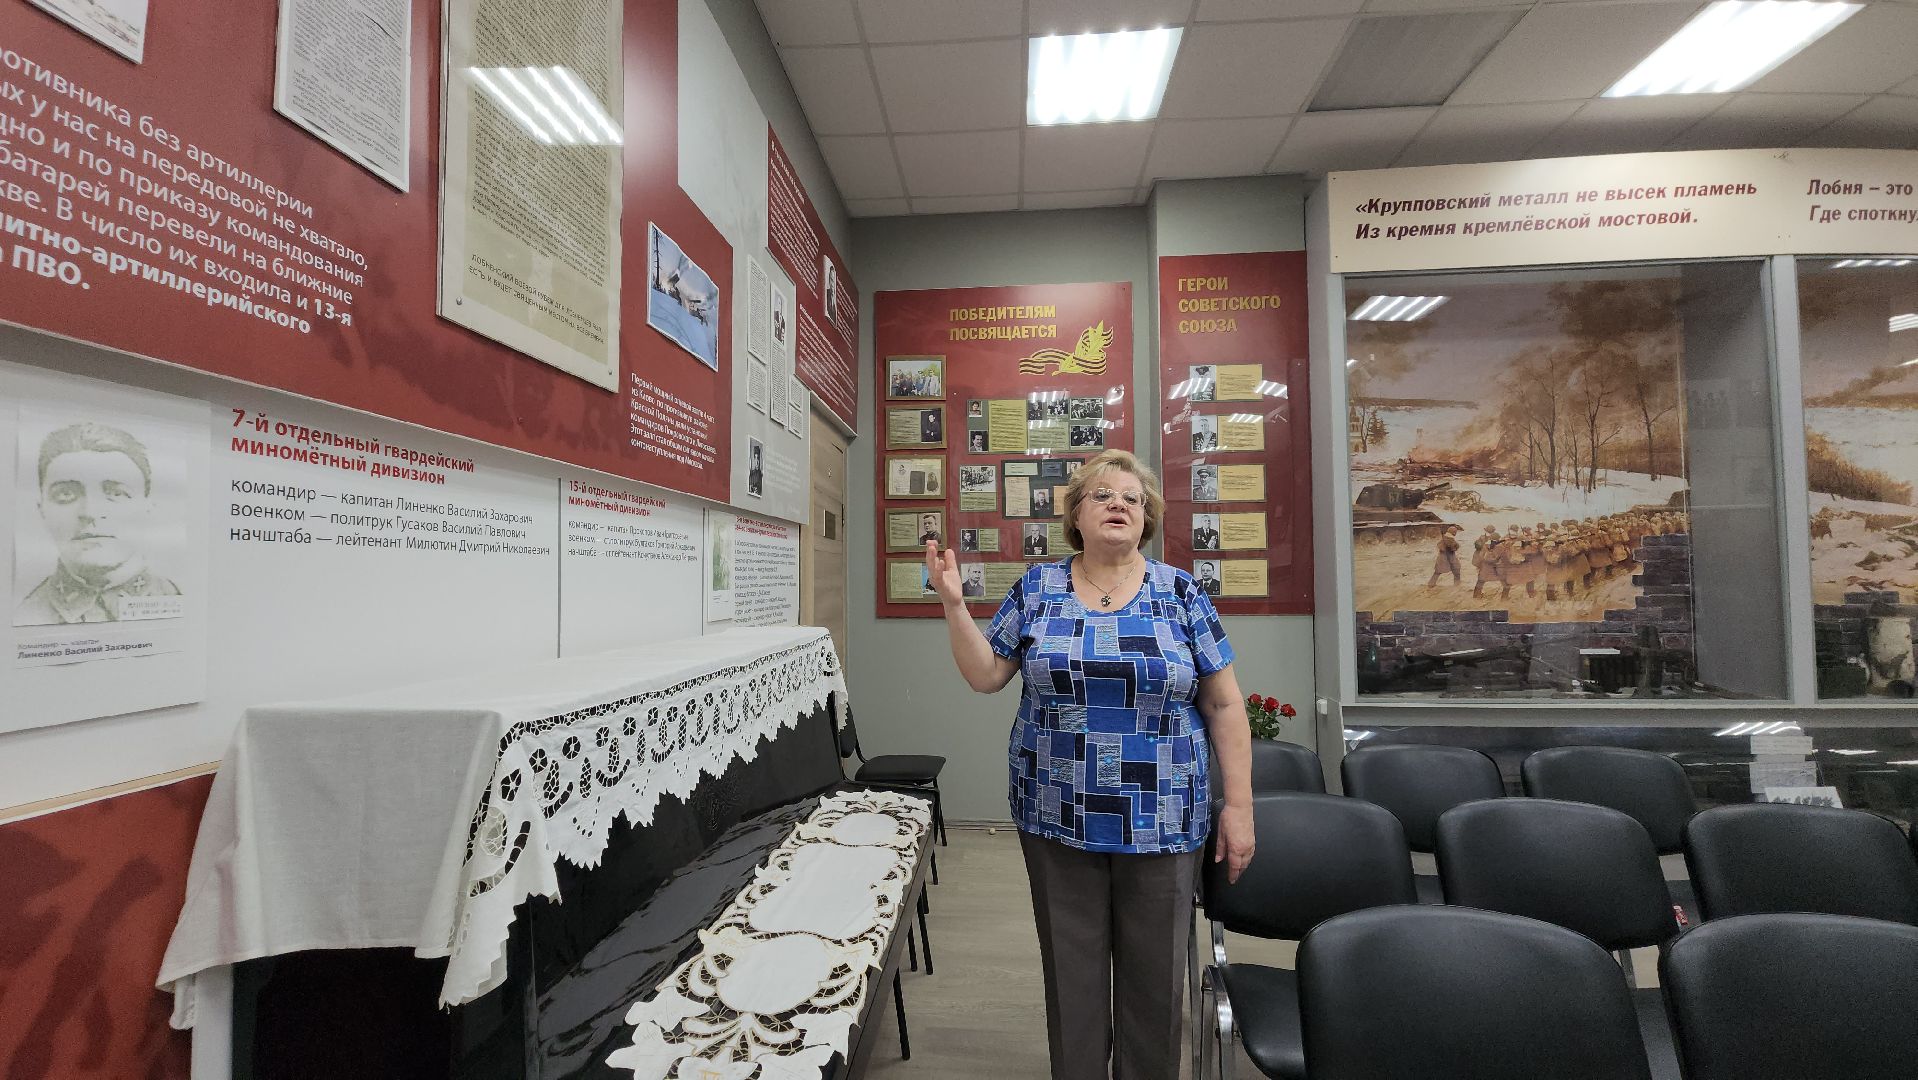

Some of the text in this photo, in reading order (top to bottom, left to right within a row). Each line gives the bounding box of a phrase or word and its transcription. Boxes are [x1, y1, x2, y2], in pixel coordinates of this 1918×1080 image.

[0, 47, 313, 219] отивника без артиллерии
[30, 94, 47, 118] у
[53, 105, 100, 141] нас
[106, 131, 135, 158] на
[143, 149, 267, 221] передовой
[272, 211, 296, 234] не
[300, 224, 368, 271] хватало,
[1806, 179, 1863, 195] Лобня
[1885, 183, 1914, 196] это
[53, 137, 70, 159] и
[78, 149, 113, 176] по
[120, 167, 221, 227] приказу
[227, 215, 363, 288] командования
[1355, 183, 1757, 217] «Крупповский металл не высек пламень
[1809, 205, 1918, 224] Где споткну
[1355, 207, 1698, 241] Из кремня кремлёвской мостовой.
[12, 244, 90, 290] ПВО.
[57, 196, 73, 221] В
[81, 211, 162, 255] число
[169, 245, 198, 269] их
[204, 258, 291, 304] входила
[297, 294, 309, 310] и
[314, 298, 352, 327] 13-я
[118, 196, 236, 257] перевели
[243, 249, 267, 270] на
[272, 258, 353, 305] ближние
[0, 212, 311, 334] итно-артиллерийского
[1178, 277, 1229, 292] ГЕРОИ
[950, 304, 1057, 323] ПОБЕДИТЕЛЯМ
[1178, 295, 1281, 313] СОВЕТСКОГО
[950, 324, 1057, 341] ПОСВЯЩАЕТСЯ
[1179, 319, 1238, 334] СОЮЗА
[232, 408, 474, 473] 7-й отдельный гвардейский
[231, 437, 445, 485] миномётный дивизион
[231, 479, 317, 504] командир
[341, 492, 393, 509] капитан
[395, 497, 445, 515] Линенко
[447, 503, 488, 520] Василий
[490, 508, 533, 525] Захарович
[568, 496, 650, 517] миномётный дивизион
[569, 480, 666, 509] 15-й отдельный гвардейский
[231, 503, 305, 521] военком
[330, 513, 393, 531] политрук
[396, 516, 439, 533] Гусаков
[442, 520, 482, 537] Василий
[484, 525, 526, 539] Павлович
[568, 520, 599, 532] командир
[230, 527, 312, 544] начштаба
[336, 532, 402, 549] лейтенант
[406, 536, 457, 551] Милютин
[459, 539, 501, 555] Дмитрий
[502, 542, 550, 556] Николаевич
[17, 642, 153, 660] Линенко Василий Захарович
